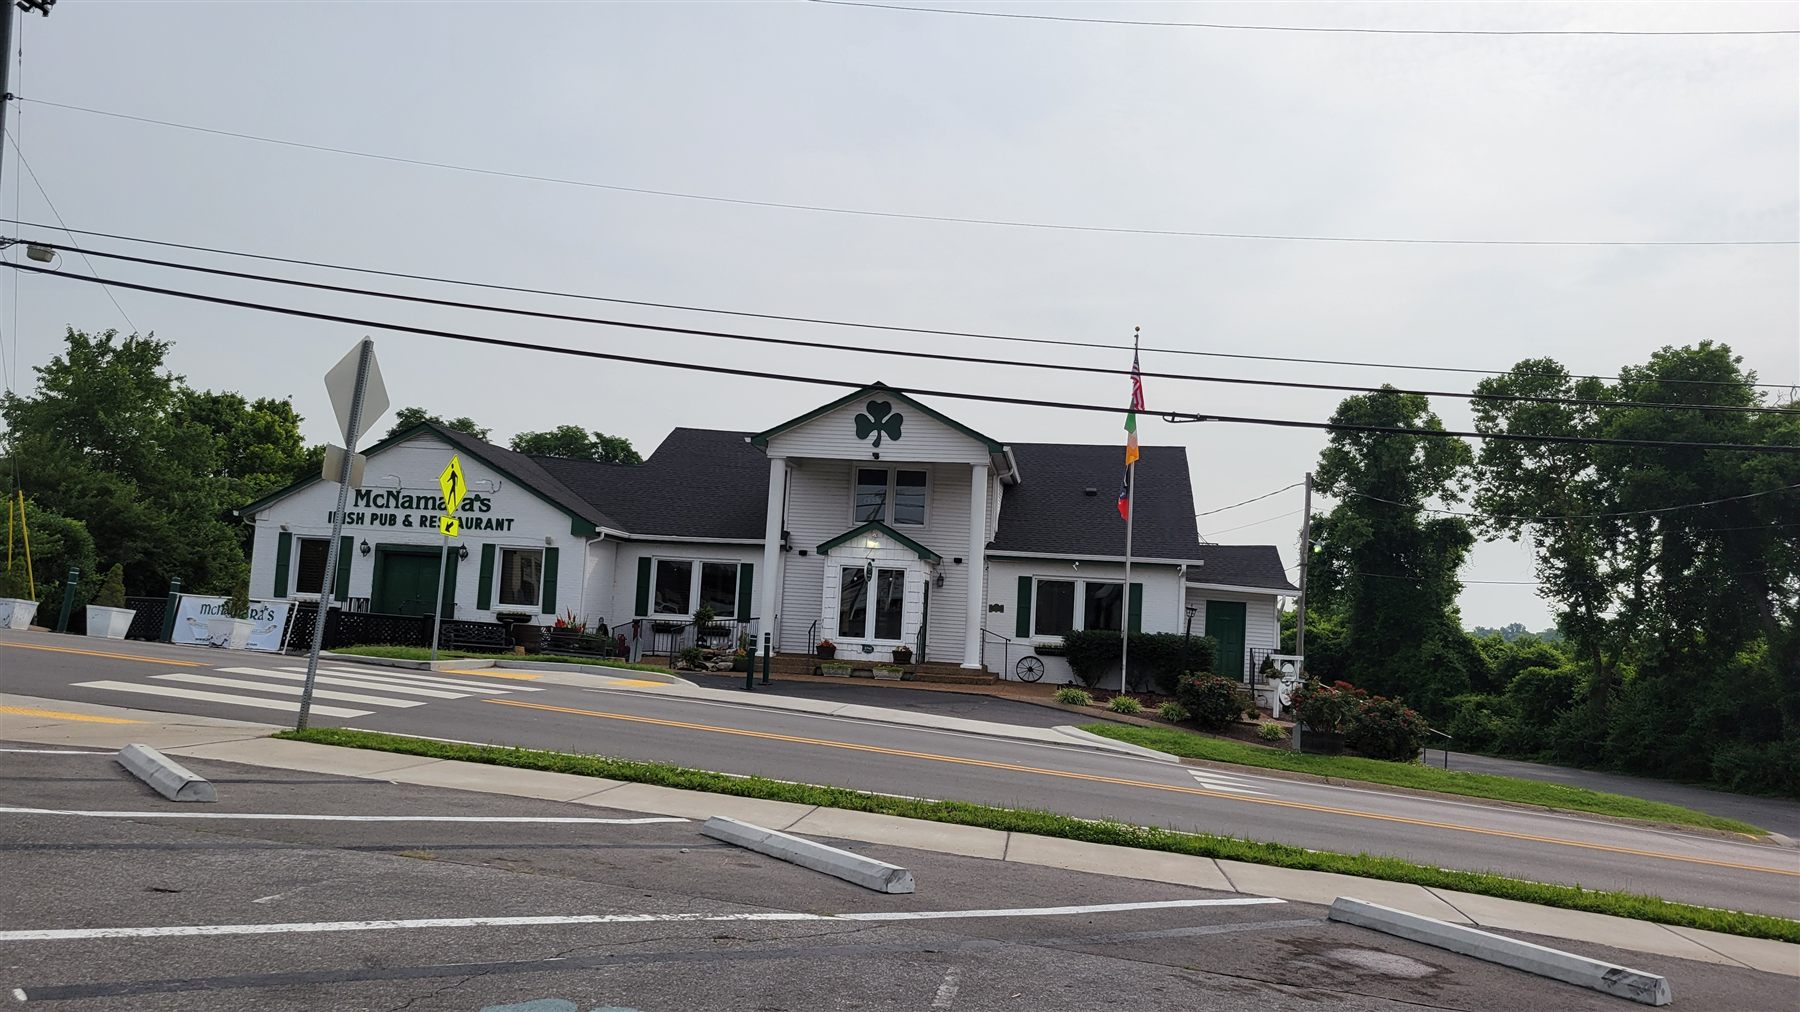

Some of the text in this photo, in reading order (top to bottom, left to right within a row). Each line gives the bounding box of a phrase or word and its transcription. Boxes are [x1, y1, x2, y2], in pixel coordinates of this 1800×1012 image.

[353, 488, 492, 513] McNamaa's
[370, 512, 397, 526] PUB
[402, 514, 413, 527] &
[419, 514, 515, 531] REAURANT
